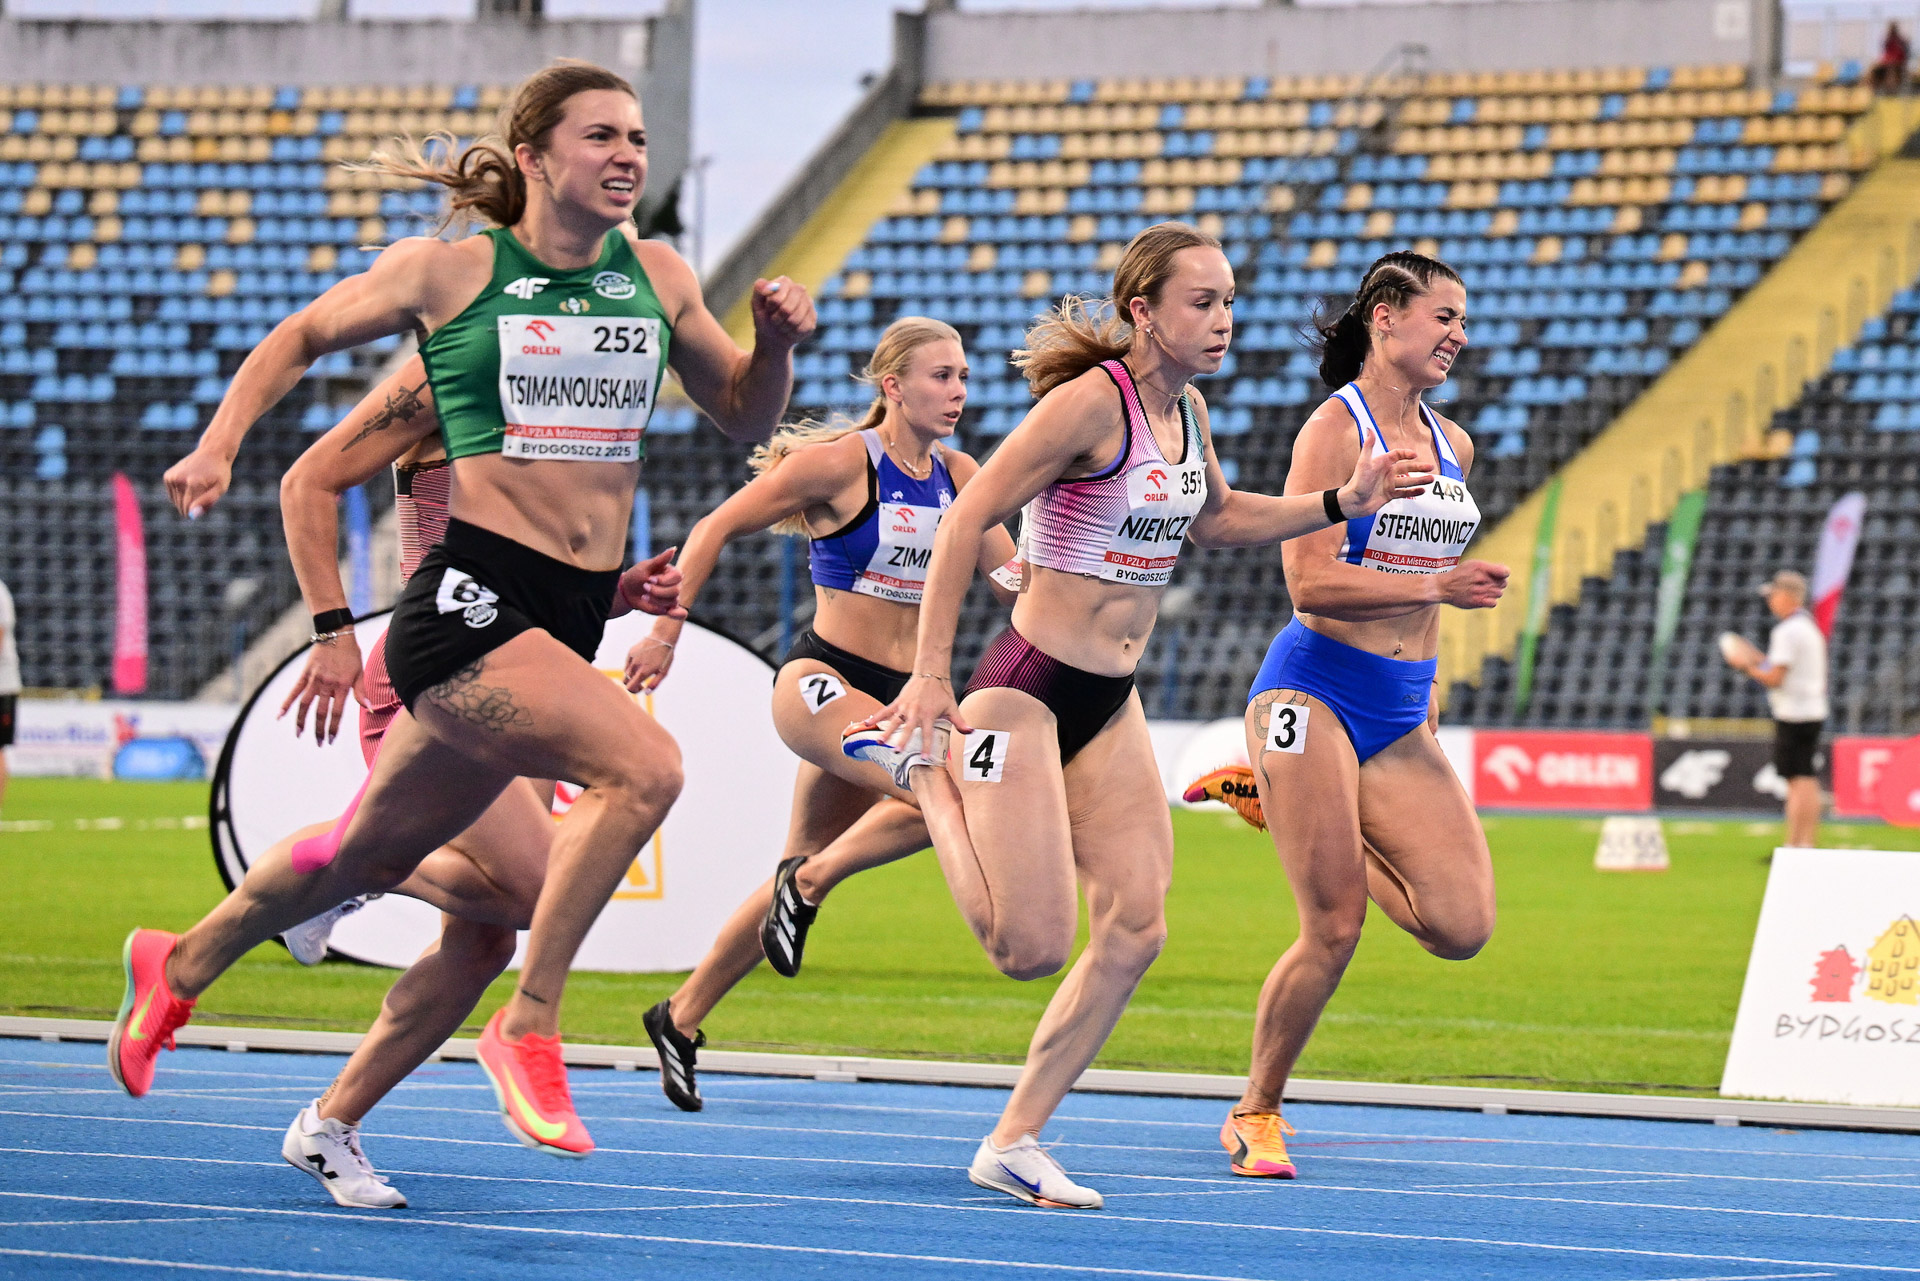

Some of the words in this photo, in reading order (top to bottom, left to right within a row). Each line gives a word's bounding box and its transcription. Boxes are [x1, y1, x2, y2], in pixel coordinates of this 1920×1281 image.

[503, 276, 550, 300] 4F
[521, 345, 561, 355] ORLEN
[594, 326, 647, 354] 252
[507, 374, 647, 408] TSIMANOUSKAYA
[528, 426, 554, 438] PZLA
[556, 427, 618, 440] Mistrzostwa
[521, 443, 602, 457] BYDGOSZCZ
[604, 446, 631, 457] 2025
[1144, 493, 1168, 502] ORLEN
[1432, 481, 1464, 502] 449
[892, 525, 917, 534] ORLEN
[1375, 513, 1475, 544] STEFANOWICZ
[1110, 553, 1125, 564] 101.
[1126, 556, 1146, 568] PZLA
[1370, 551, 1385, 560] 101.
[1387, 554, 1405, 564] PZLA
[882, 576, 900, 587] PZLA
[808, 677, 836, 707] 2
[1274, 708, 1297, 748] 3
[969, 735, 995, 778] 4
[1537, 753, 1639, 788] ORLEN
